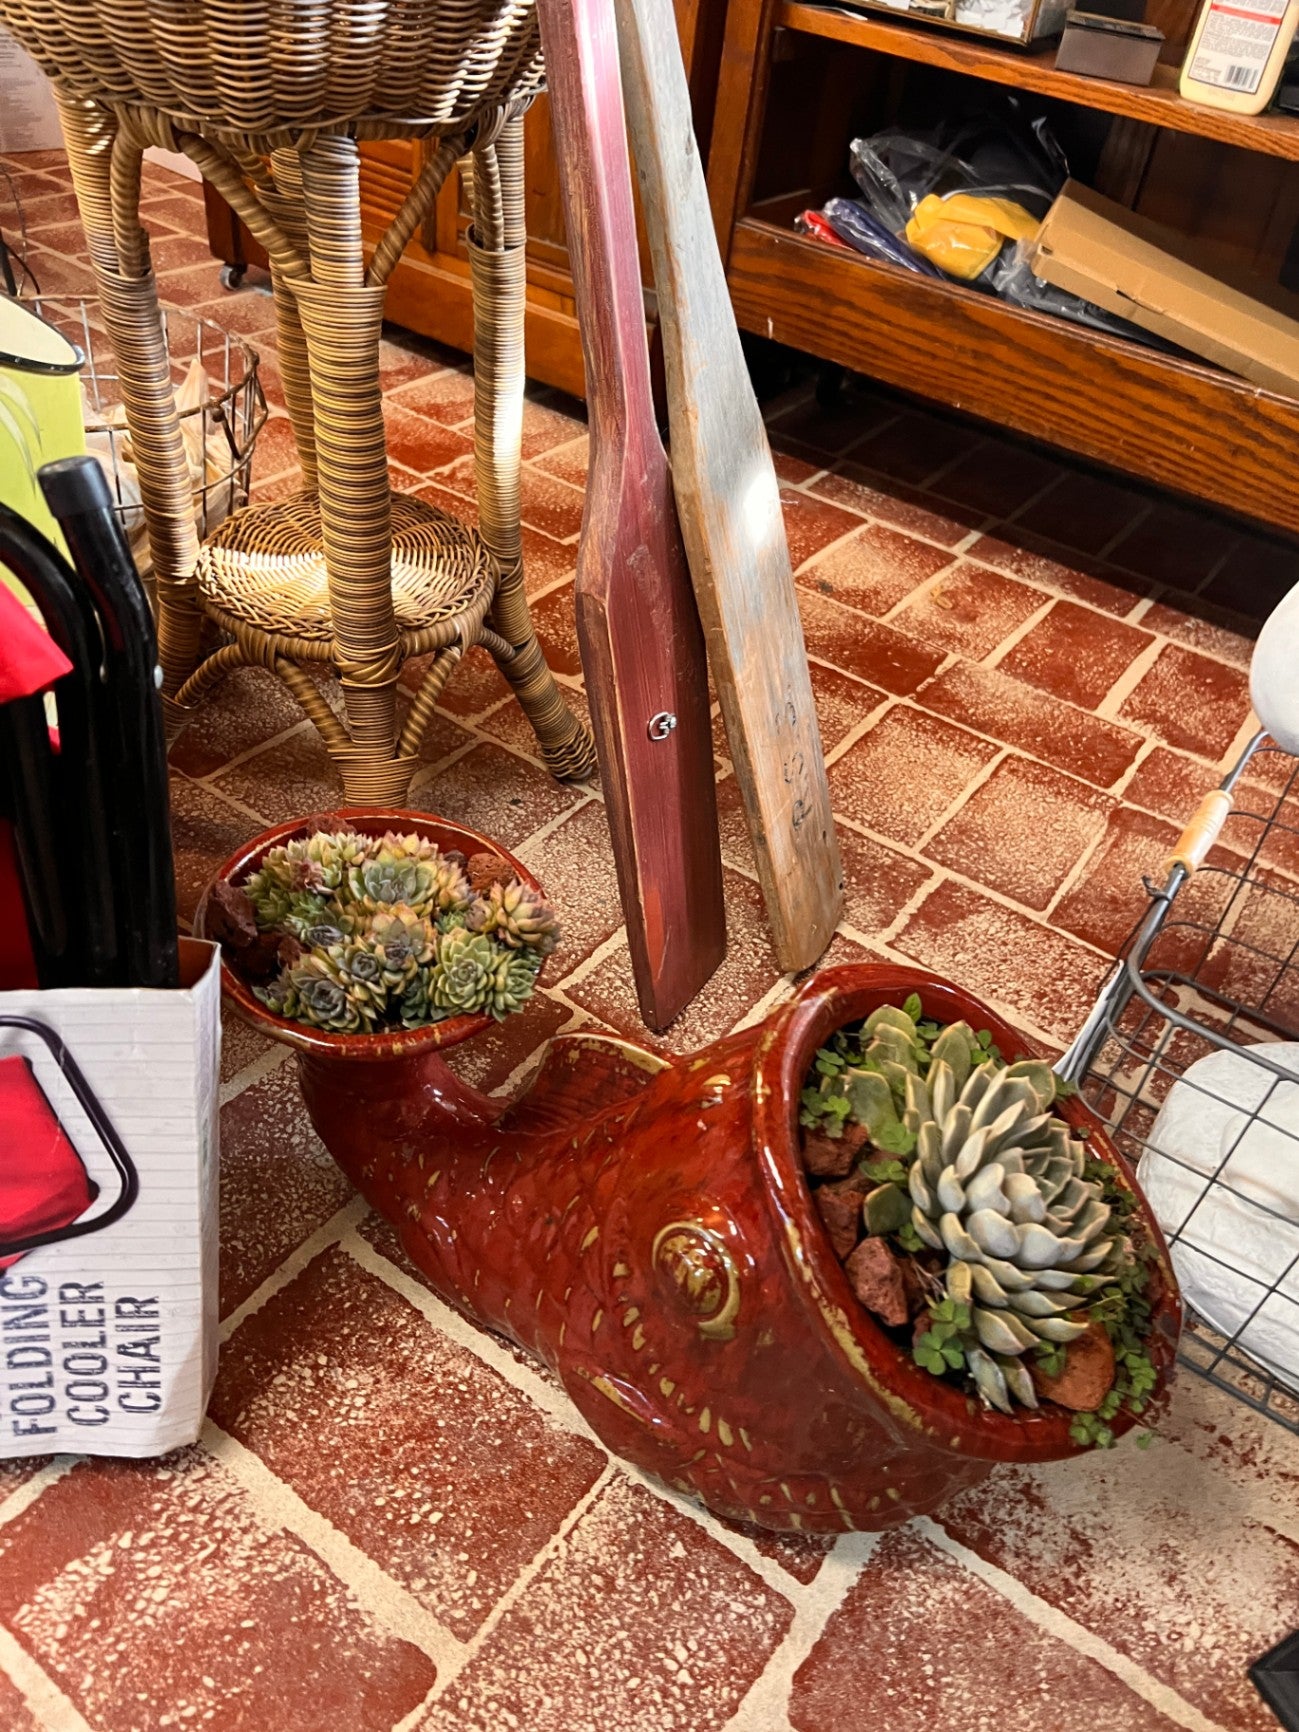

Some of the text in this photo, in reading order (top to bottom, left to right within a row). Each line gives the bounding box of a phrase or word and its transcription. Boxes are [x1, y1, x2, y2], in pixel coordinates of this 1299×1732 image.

[0, 1276, 57, 1436] FOLDING
[59, 1282, 110, 1426] COOLER
[115, 1296, 161, 1414] CHAIR
